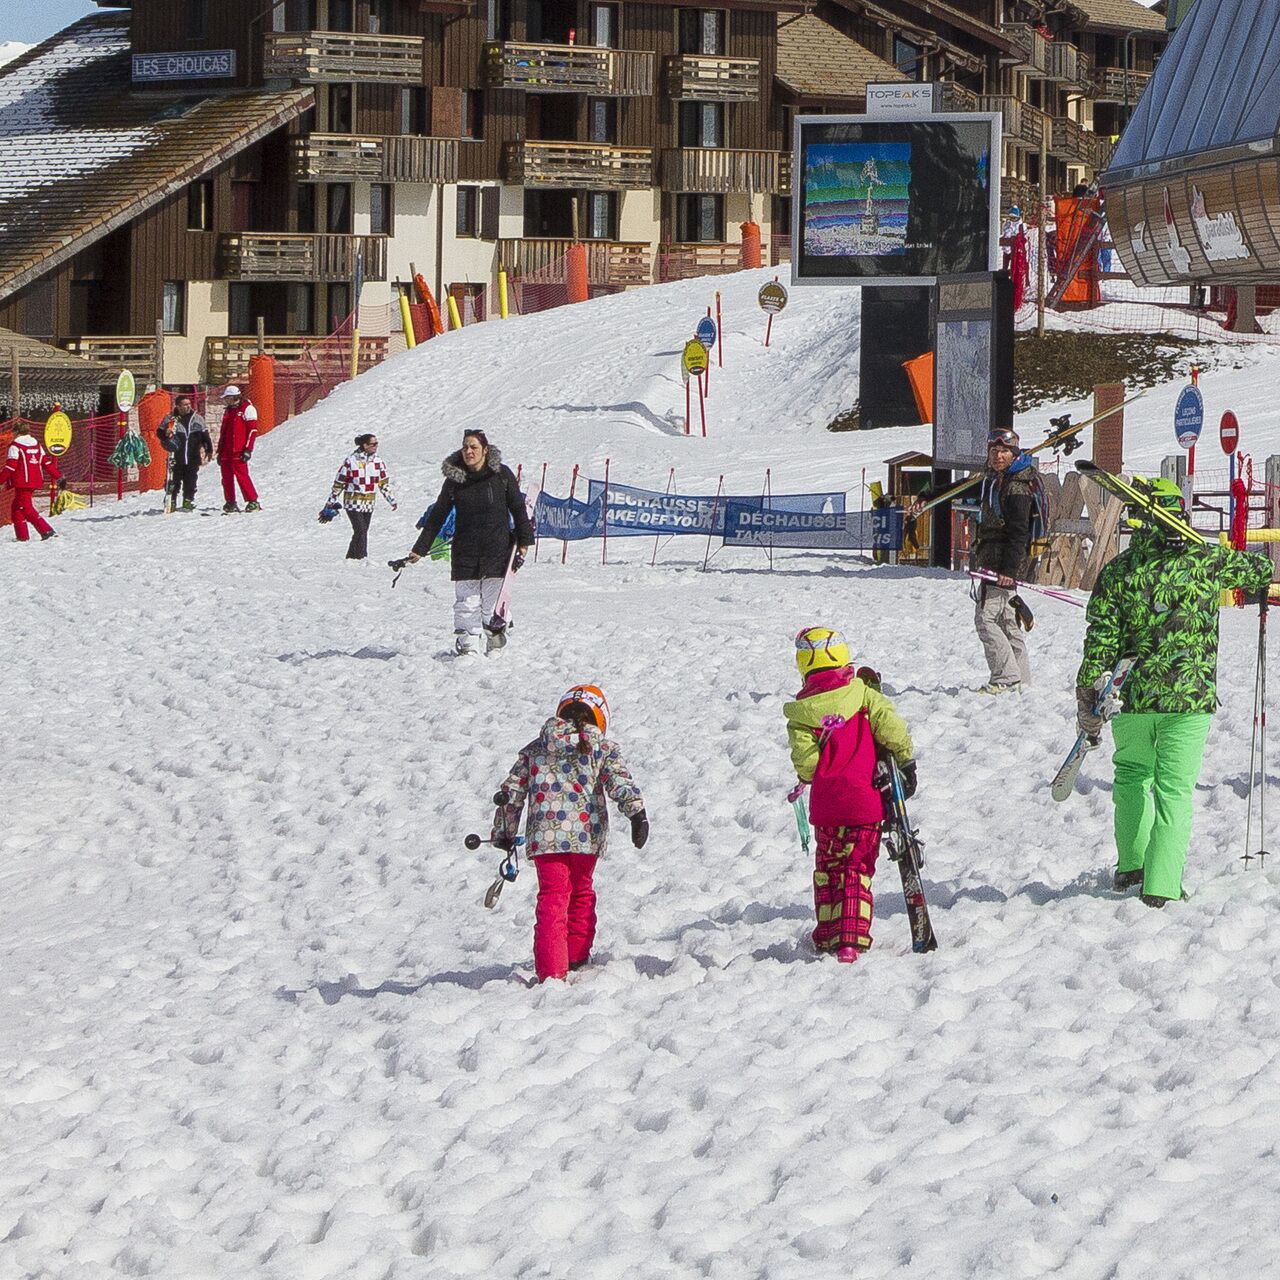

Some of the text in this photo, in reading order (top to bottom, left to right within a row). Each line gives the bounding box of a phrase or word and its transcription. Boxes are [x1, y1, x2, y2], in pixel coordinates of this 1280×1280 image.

[135, 55, 229, 75] LES CHOUCAS
[868, 90, 931, 99] TOPEAKS
[605, 510, 636, 522] AKE
[640, 513, 669, 525] OFF
[739, 510, 847, 528] DÉCHAUSSE
